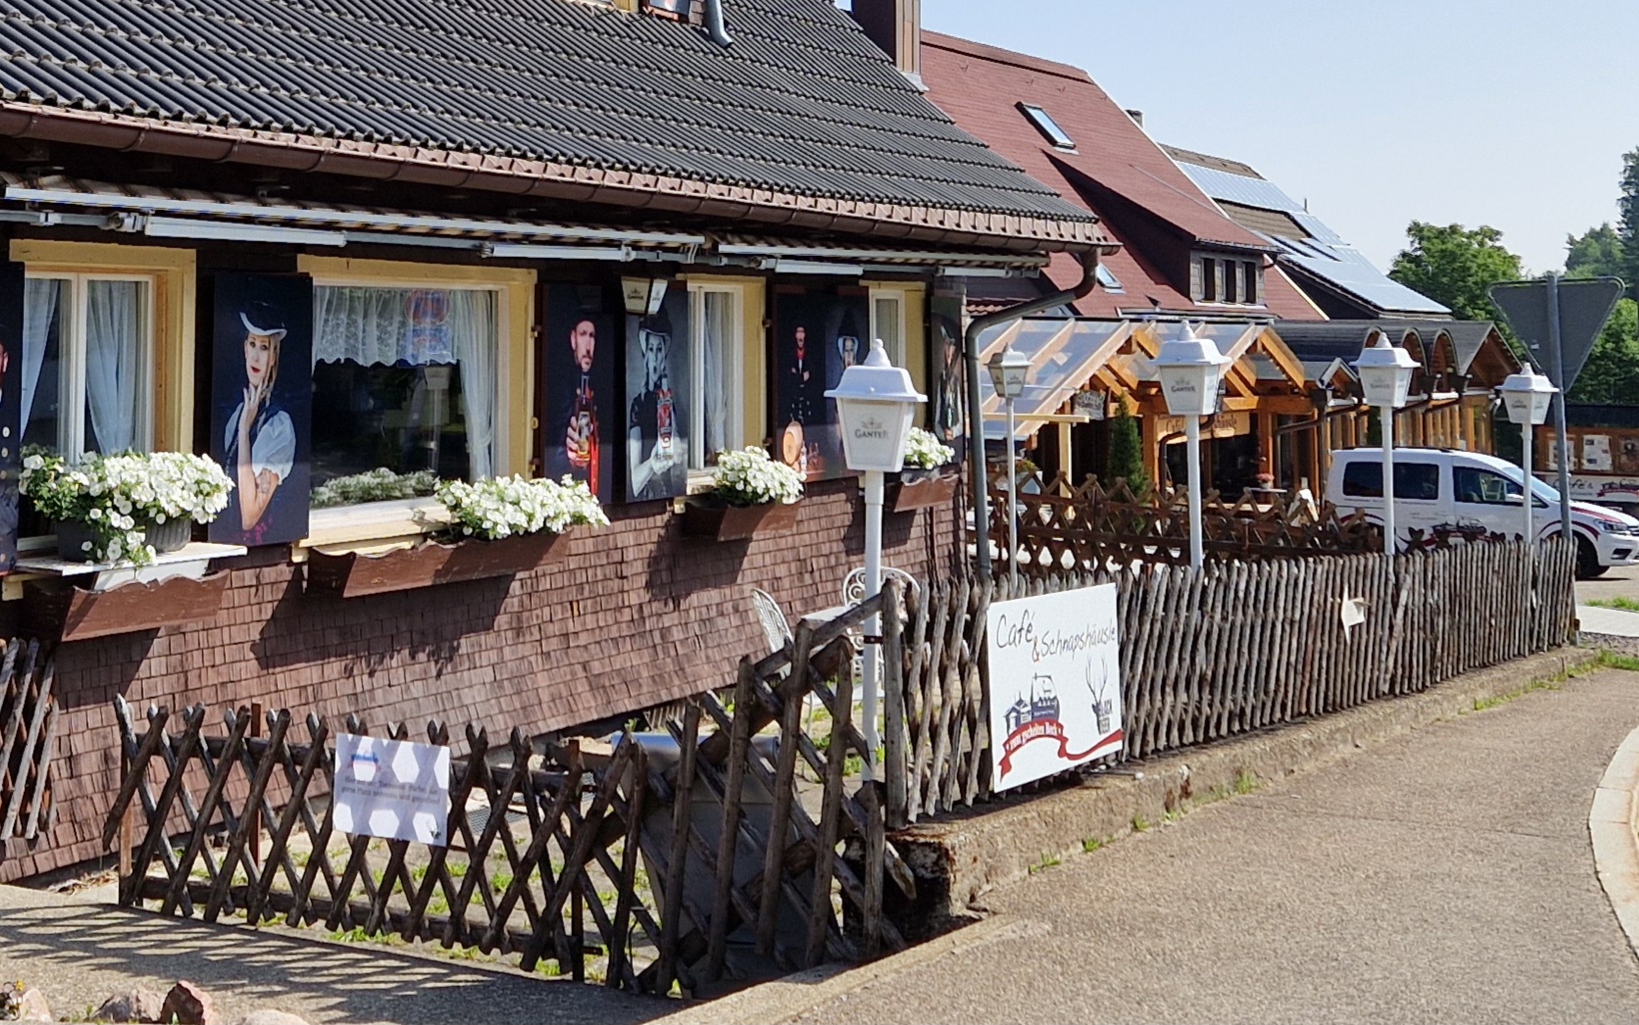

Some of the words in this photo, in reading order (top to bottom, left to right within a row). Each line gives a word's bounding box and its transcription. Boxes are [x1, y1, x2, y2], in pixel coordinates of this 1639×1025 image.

[855, 429, 888, 440] GANTER
[996, 609, 1036, 648] Café
[1032, 636, 1040, 663] &
[1041, 618, 1116, 661] Schnapshäusle
